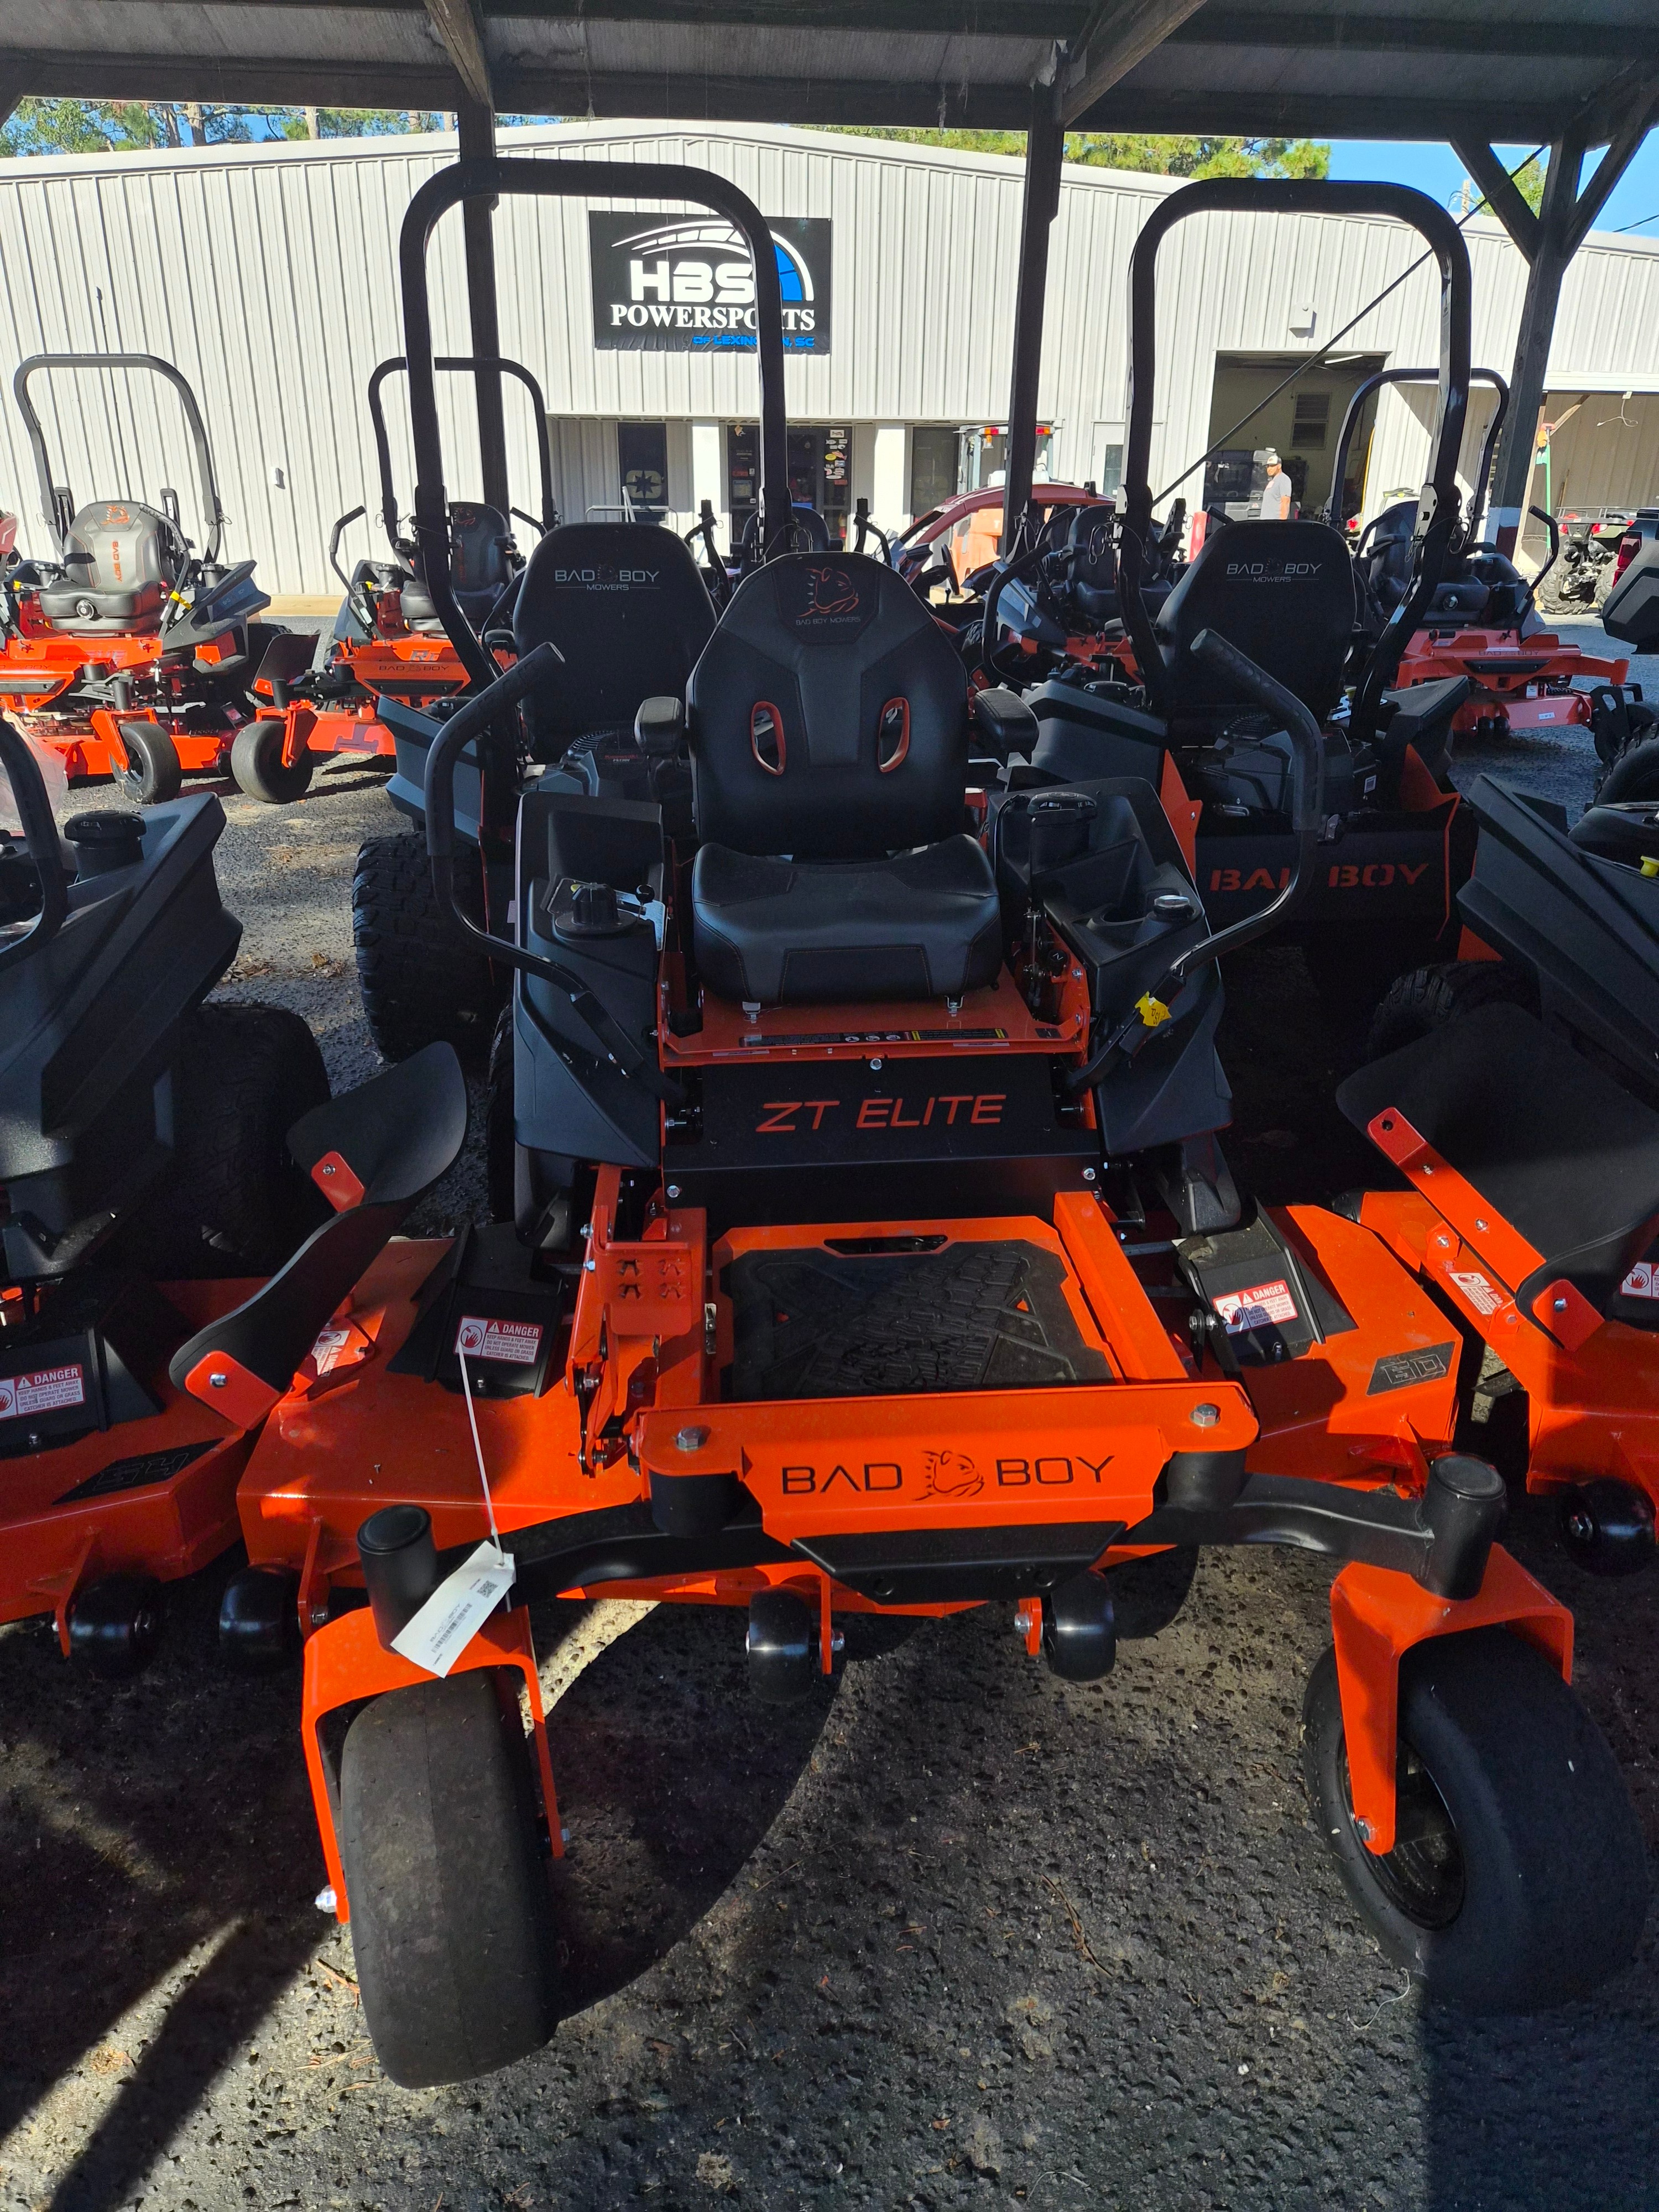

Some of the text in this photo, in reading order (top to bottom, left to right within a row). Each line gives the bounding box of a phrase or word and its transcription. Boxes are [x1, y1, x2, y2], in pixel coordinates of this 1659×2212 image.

[630, 260, 755, 304] HBS
[610, 304, 816, 331] POWERSPOTS
[693, 336, 711, 345] OF
[795, 337, 815, 347] SC
[113, 564, 122, 582] BOY
[555, 570, 660, 582] BAD BOY
[1227, 563, 1322, 574] BAD BOY
[1329, 863, 1429, 888] BOY
[756, 1094, 1006, 1132] ZT ELITE
[1253, 1284, 1286, 1300] DANGER
[503, 1324, 539, 1337] DANGER
[34, 1368, 78, 1385] DANGER
[39, 1389, 60, 1397] OPERATE
[781, 1455, 1115, 1494] BAD BOY
